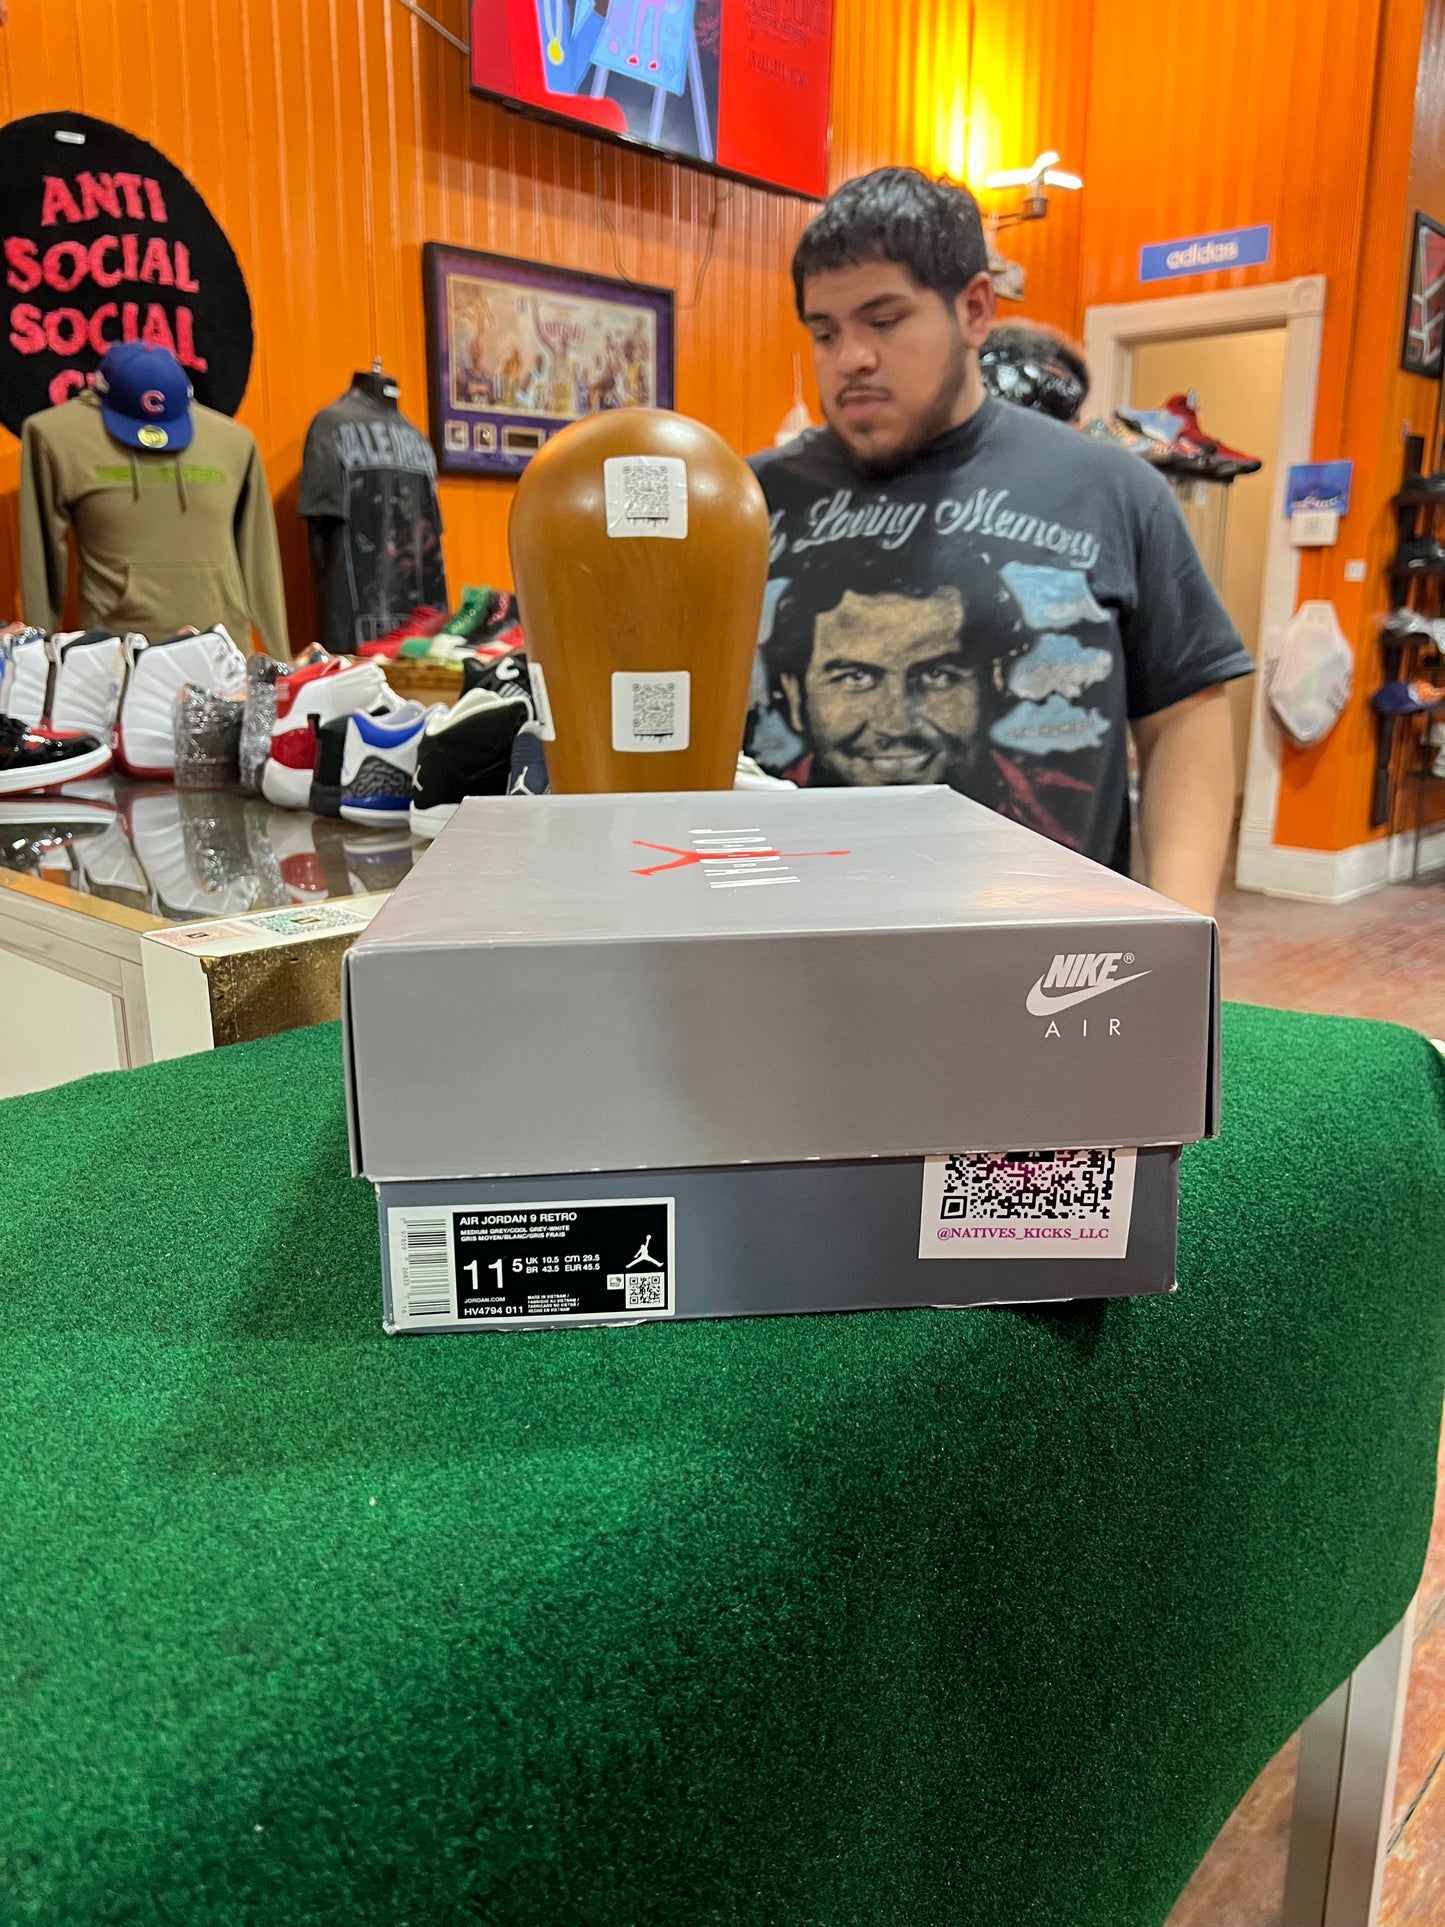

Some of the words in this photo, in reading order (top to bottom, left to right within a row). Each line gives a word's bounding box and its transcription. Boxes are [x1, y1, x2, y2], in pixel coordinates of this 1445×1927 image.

[41, 171, 168, 227] ANTI
[4, 233, 200, 293] SOCIAL
[1166, 241, 1239, 270] adidas
[9, 302, 208, 373] SOCIAL
[791, 489, 927, 550] Loving
[934, 487, 1100, 569] Memory
[1043, 952, 1123, 988] NIKE
[1045, 1018, 1121, 1038] AIR
[459, 1216, 479, 1226] AIR
[481, 1214, 527, 1225] JORDAN
[530, 1214, 537, 1223] 9
[540, 1212, 578, 1222] RETRO
[489, 1227, 528, 1235] GREY/COOL
[936, 1226, 1110, 1242] @NATIVES_KICKS_LLC
[526, 1266, 539, 1274] BR
[542, 1265, 559, 1273] 43.5
[564, 1264, 582, 1272] EUR
[582, 1263, 600, 1271] 45.5
[542, 1256, 559, 1264] 10.5
[582, 1254, 600, 1262] 29.5
[464, 1307, 502, 1316] HV4794
[505, 1306, 523, 1314] 011
